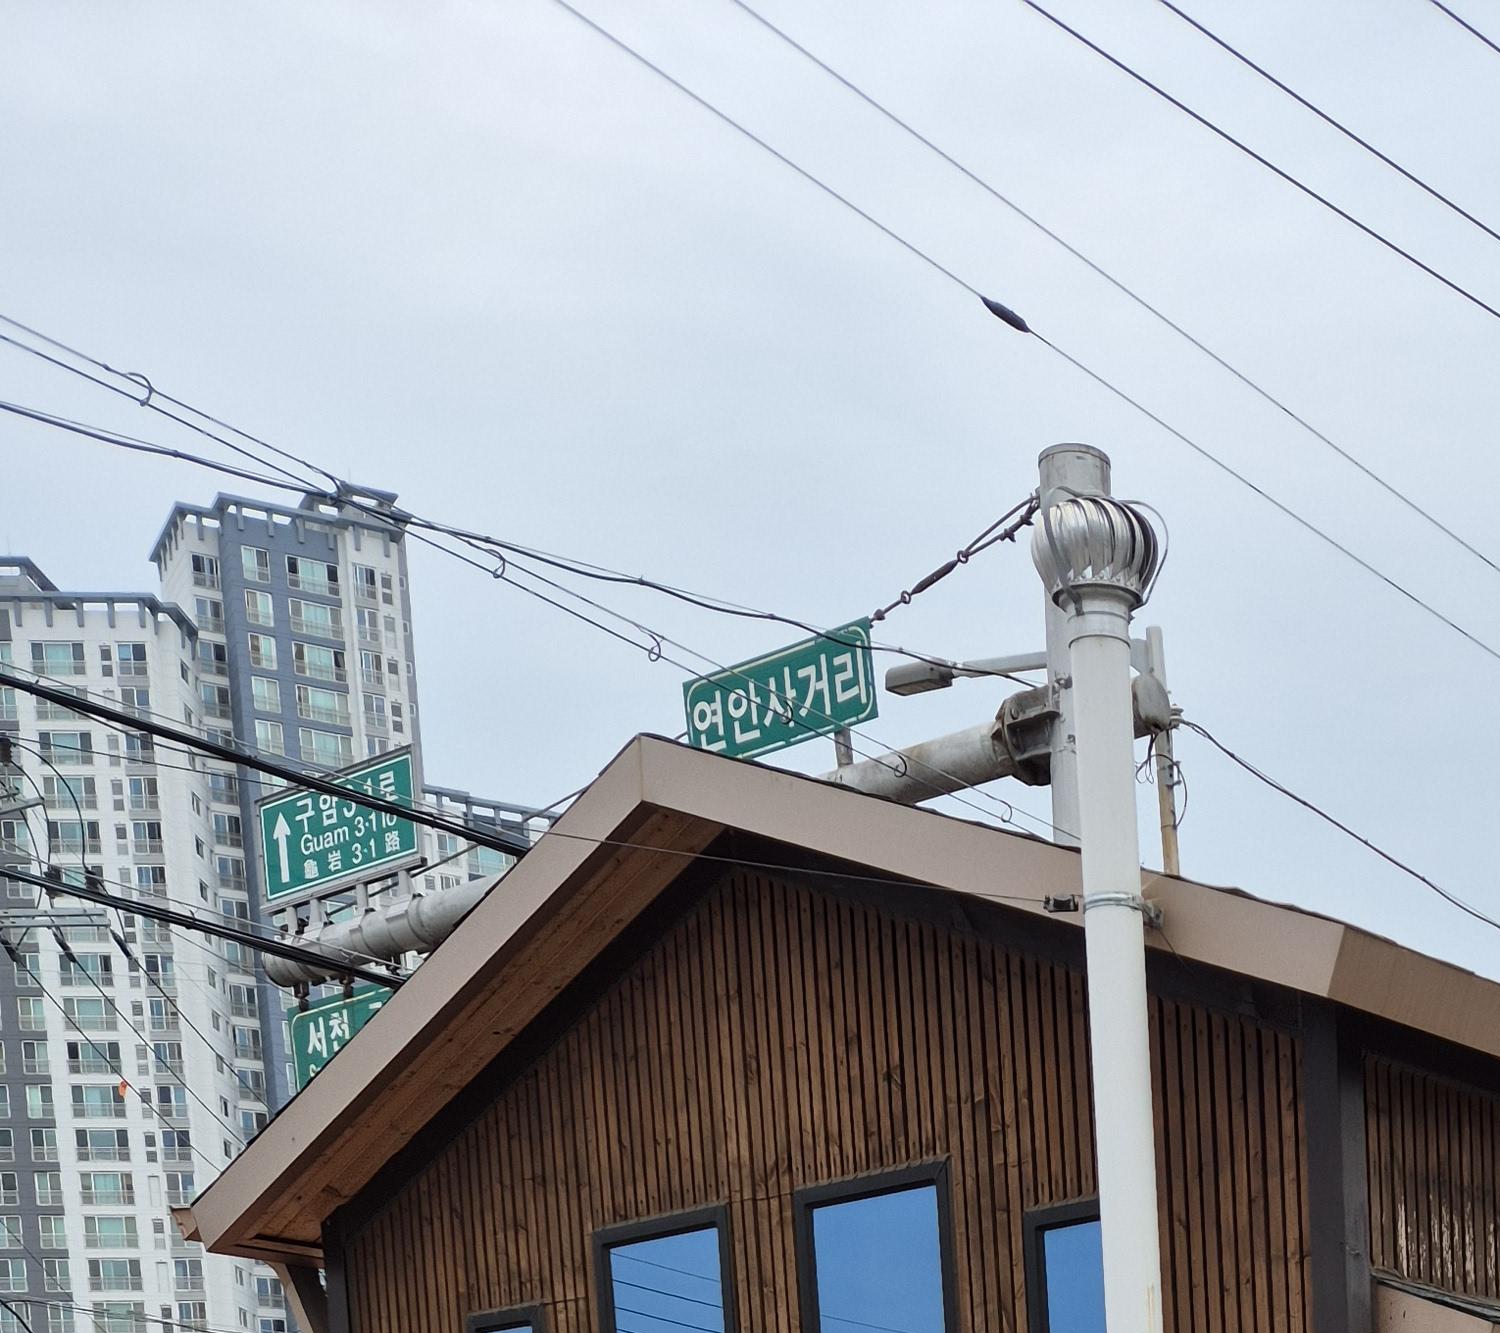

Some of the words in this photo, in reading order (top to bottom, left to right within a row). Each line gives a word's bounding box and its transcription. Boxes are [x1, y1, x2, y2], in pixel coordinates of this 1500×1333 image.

[693, 640, 867, 752] 연안사거리
[300, 826, 350, 856] Guam
[307, 1008, 350, 1058] 서천
